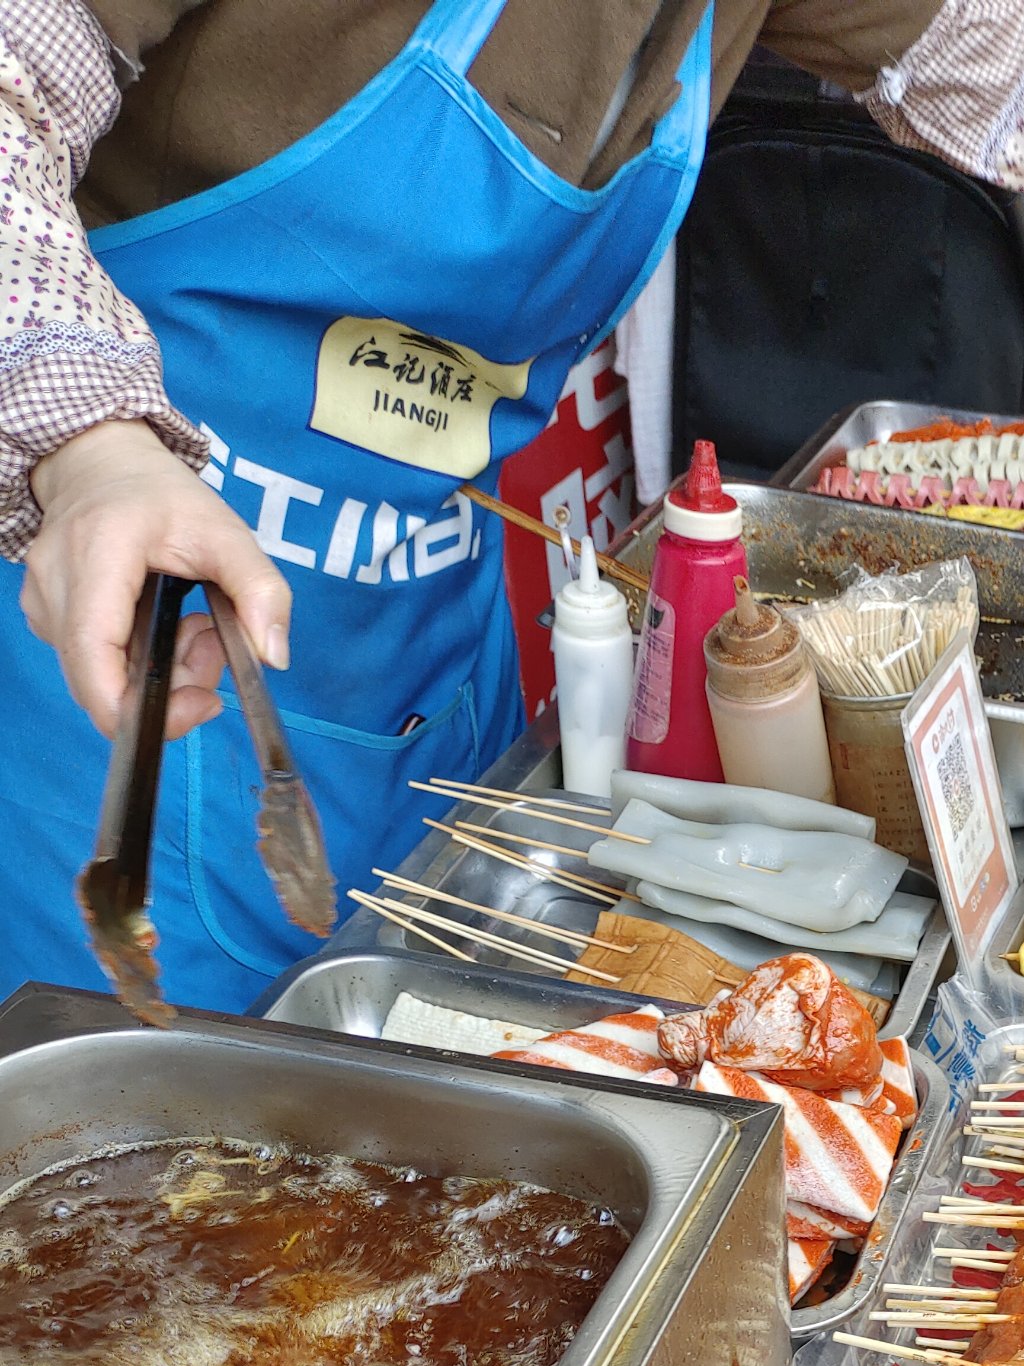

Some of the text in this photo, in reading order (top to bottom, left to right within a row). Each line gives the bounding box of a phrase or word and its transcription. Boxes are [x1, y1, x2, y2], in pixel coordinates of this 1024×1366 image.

[349, 336, 478, 404] 江记酒庄
[373, 389, 450, 433] JIANGJI
